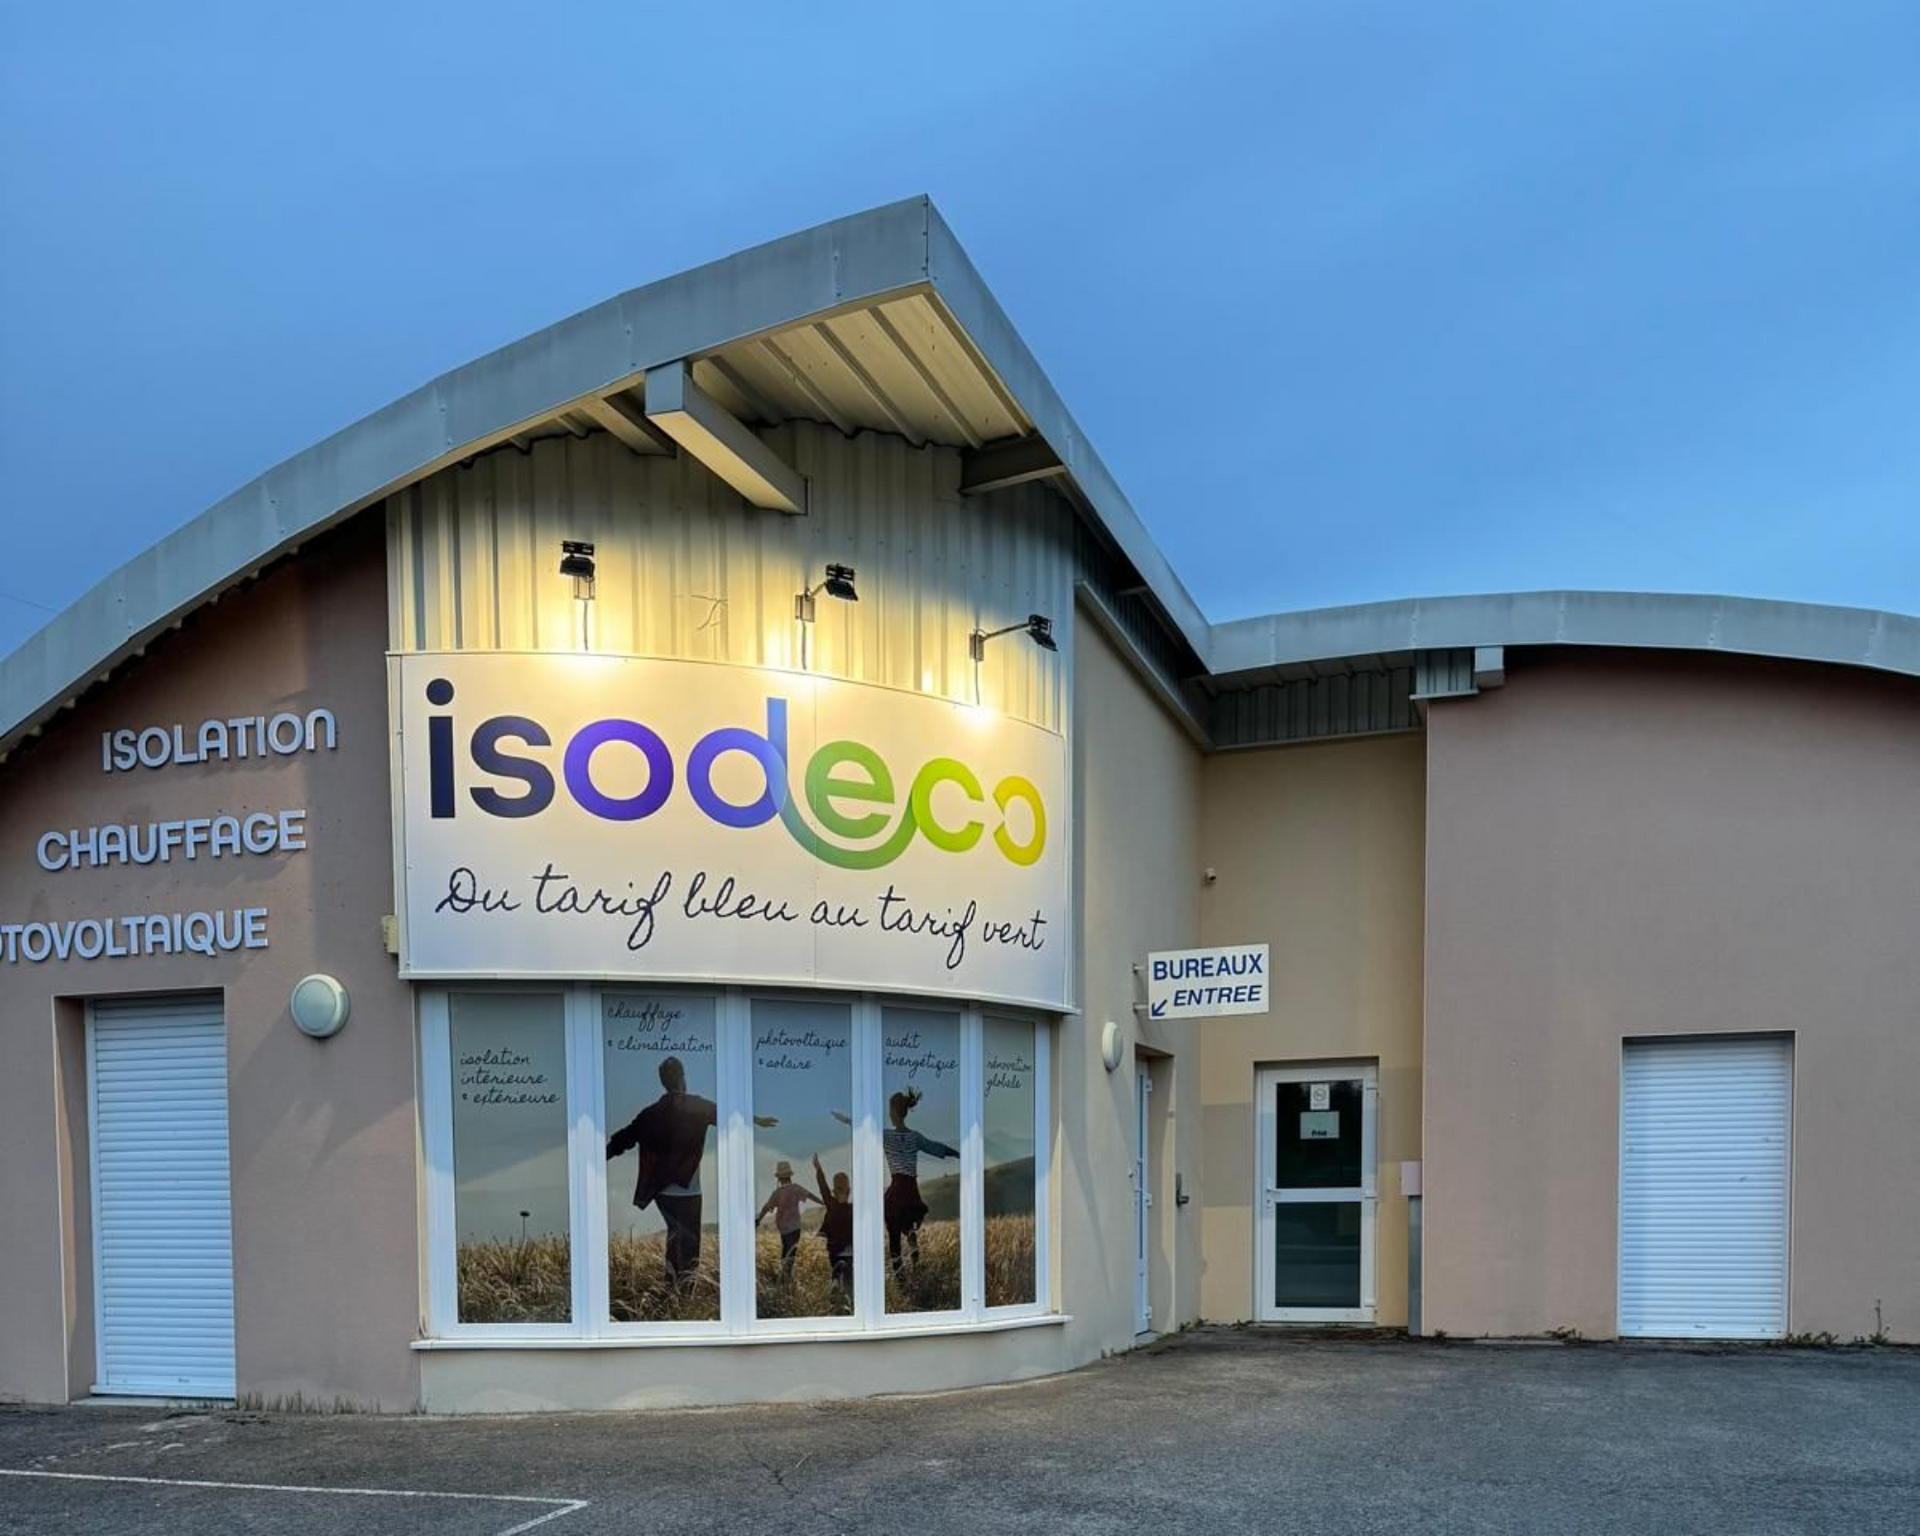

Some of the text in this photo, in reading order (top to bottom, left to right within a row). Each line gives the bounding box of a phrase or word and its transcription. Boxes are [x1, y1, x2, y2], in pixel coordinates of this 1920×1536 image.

[102, 708, 338, 772] ISOLATION
[426, 677, 1047, 870] isodeco
[37, 809, 307, 871] CHAUFFAGE
[435, 863, 1048, 969] Du tarif bleu au tarif vert
[0, 908, 269, 963] TOVOLTAIQUE
[1153, 953, 1263, 981] BUREAUX
[1173, 984, 1263, 1007] ENTREE
[607, 1001, 683, 1032] chauffage
[617, 1035, 714, 1051] climatisation
[885, 1030, 922, 1049] audit
[460, 1048, 531, 1065] isolation
[766, 1054, 813, 1070] solaire
[460, 1067, 547, 1085] intérieure
[984, 1072, 1022, 1098] globale
